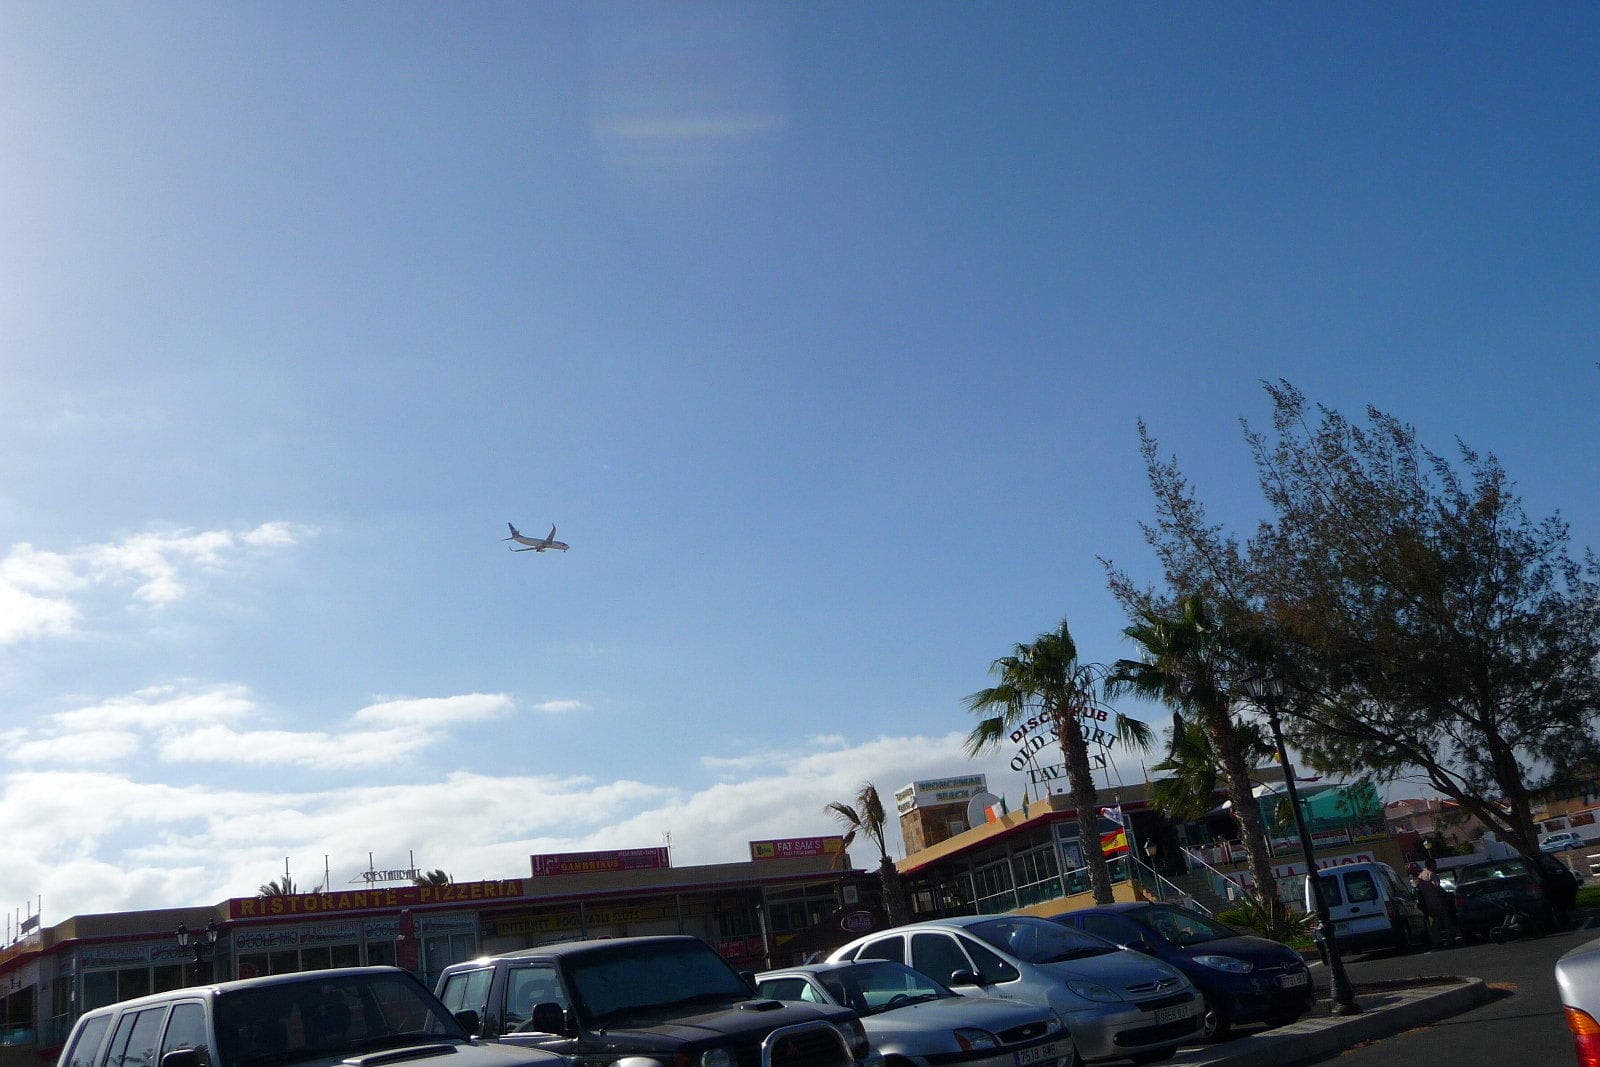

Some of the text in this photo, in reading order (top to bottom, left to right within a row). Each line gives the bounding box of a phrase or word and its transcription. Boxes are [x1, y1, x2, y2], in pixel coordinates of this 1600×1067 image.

[1009, 708, 1062, 744] DISC
[1010, 725, 1117, 772] OLD SORT
[1026, 753, 1107, 784] TAVN
[777, 842, 793, 852] FAT
[794, 840, 821, 851] SAM'S
[363, 868, 421, 882] RESTAURANT
[240, 888, 397, 916] RISTORANTE
[420, 880, 518, 903] PIZZERIA
